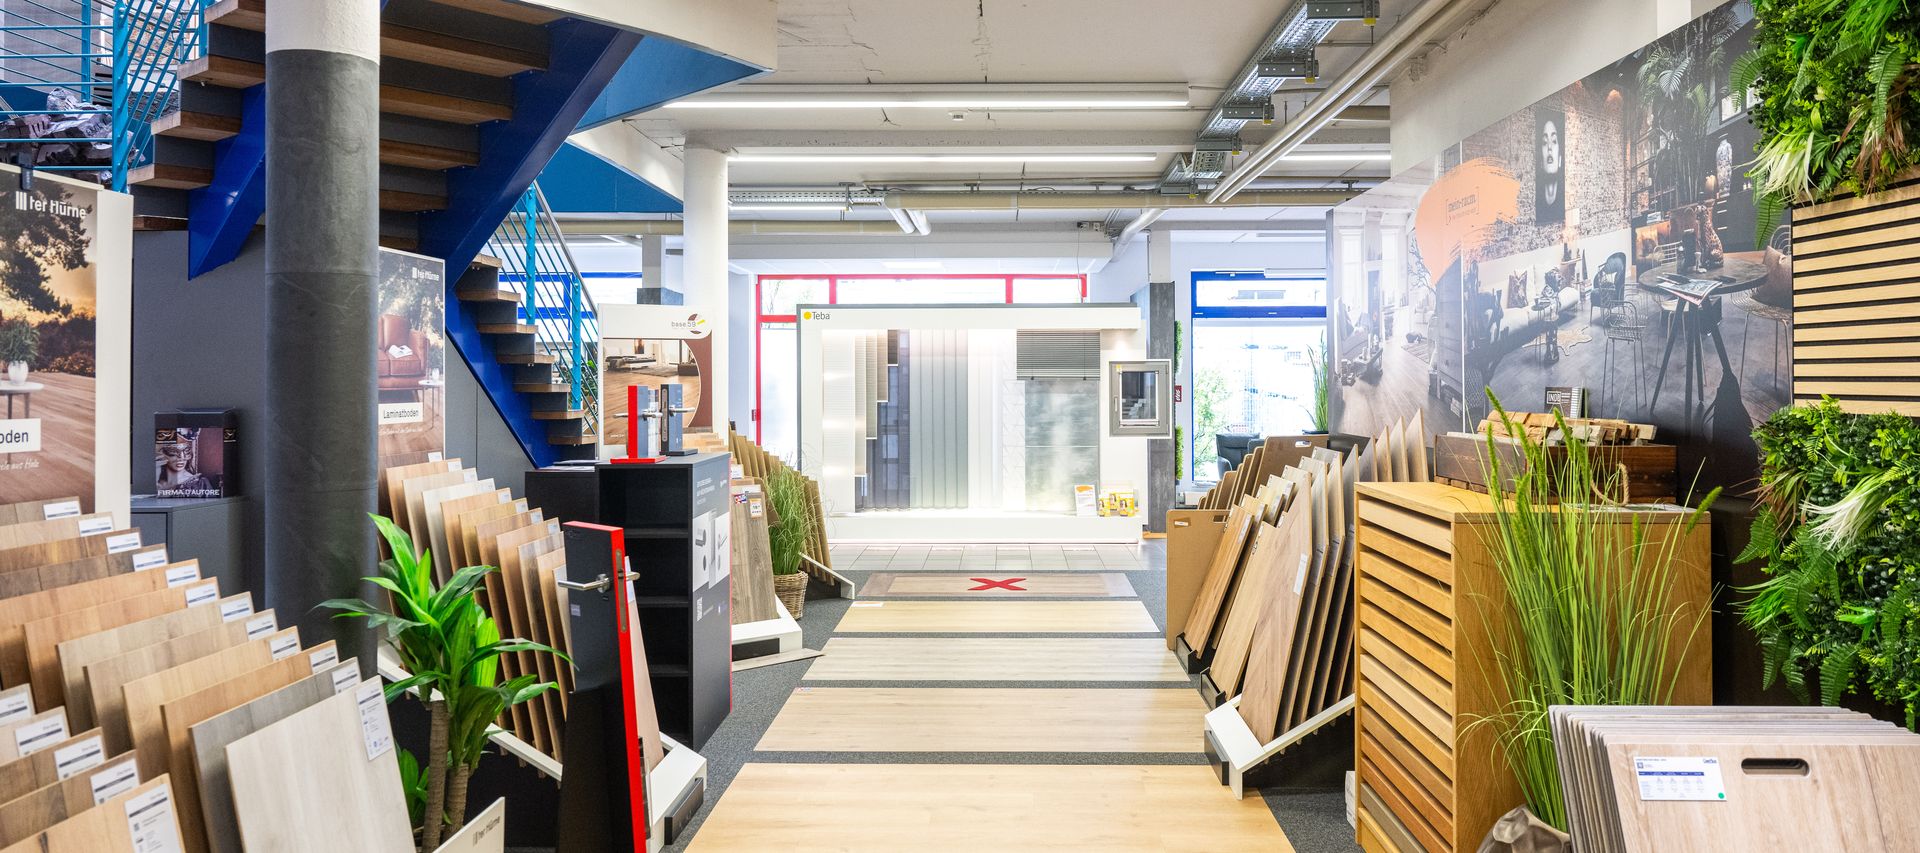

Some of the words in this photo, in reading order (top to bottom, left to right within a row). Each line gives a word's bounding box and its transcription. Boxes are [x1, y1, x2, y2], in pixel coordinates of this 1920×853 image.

[29, 195, 48, 212] ter
[812, 311, 831, 320] Teba
[383, 408, 419, 419] Laminatboden
